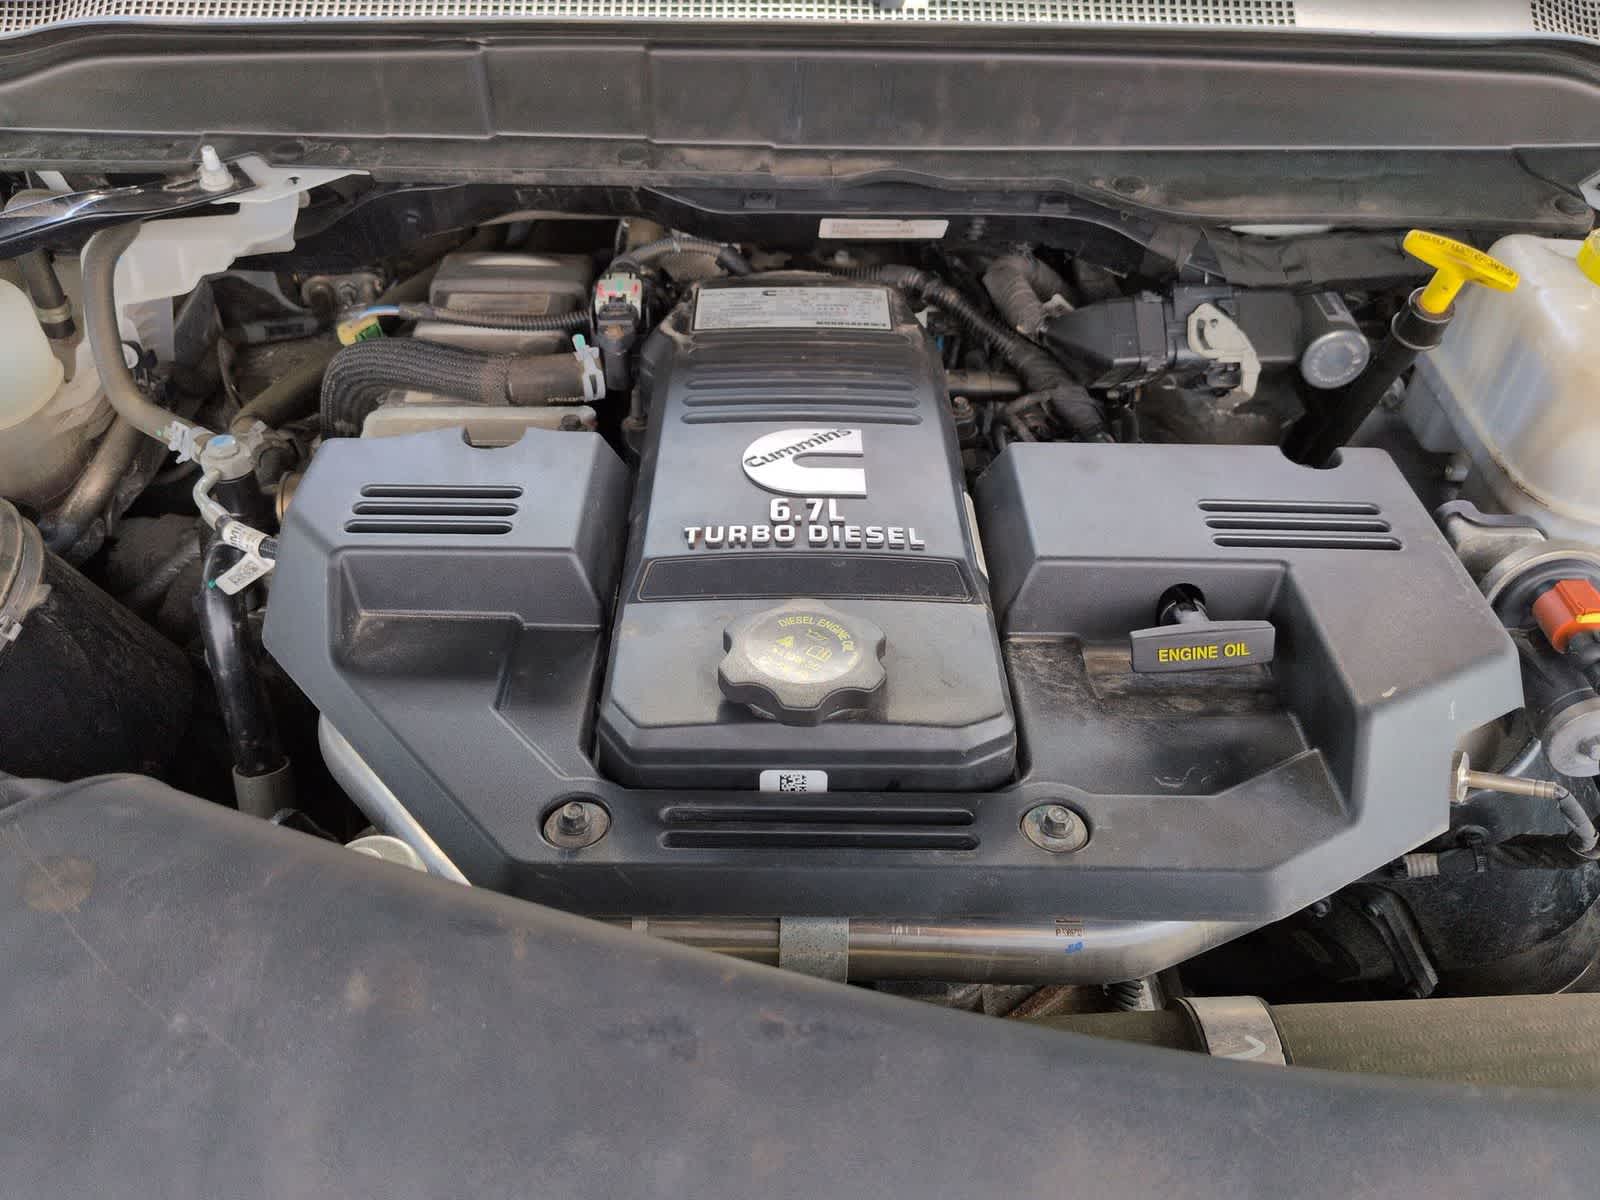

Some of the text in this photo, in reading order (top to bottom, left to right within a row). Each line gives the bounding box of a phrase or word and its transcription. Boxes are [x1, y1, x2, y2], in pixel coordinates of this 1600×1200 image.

[744, 428, 853, 468] Cummins
[769, 498, 845, 525] 6.7L
[684, 525, 926, 551] TURBO DIESEL
[777, 616, 816, 628] DIESEL
[1157, 642, 1251, 663] ENGINE OIL
